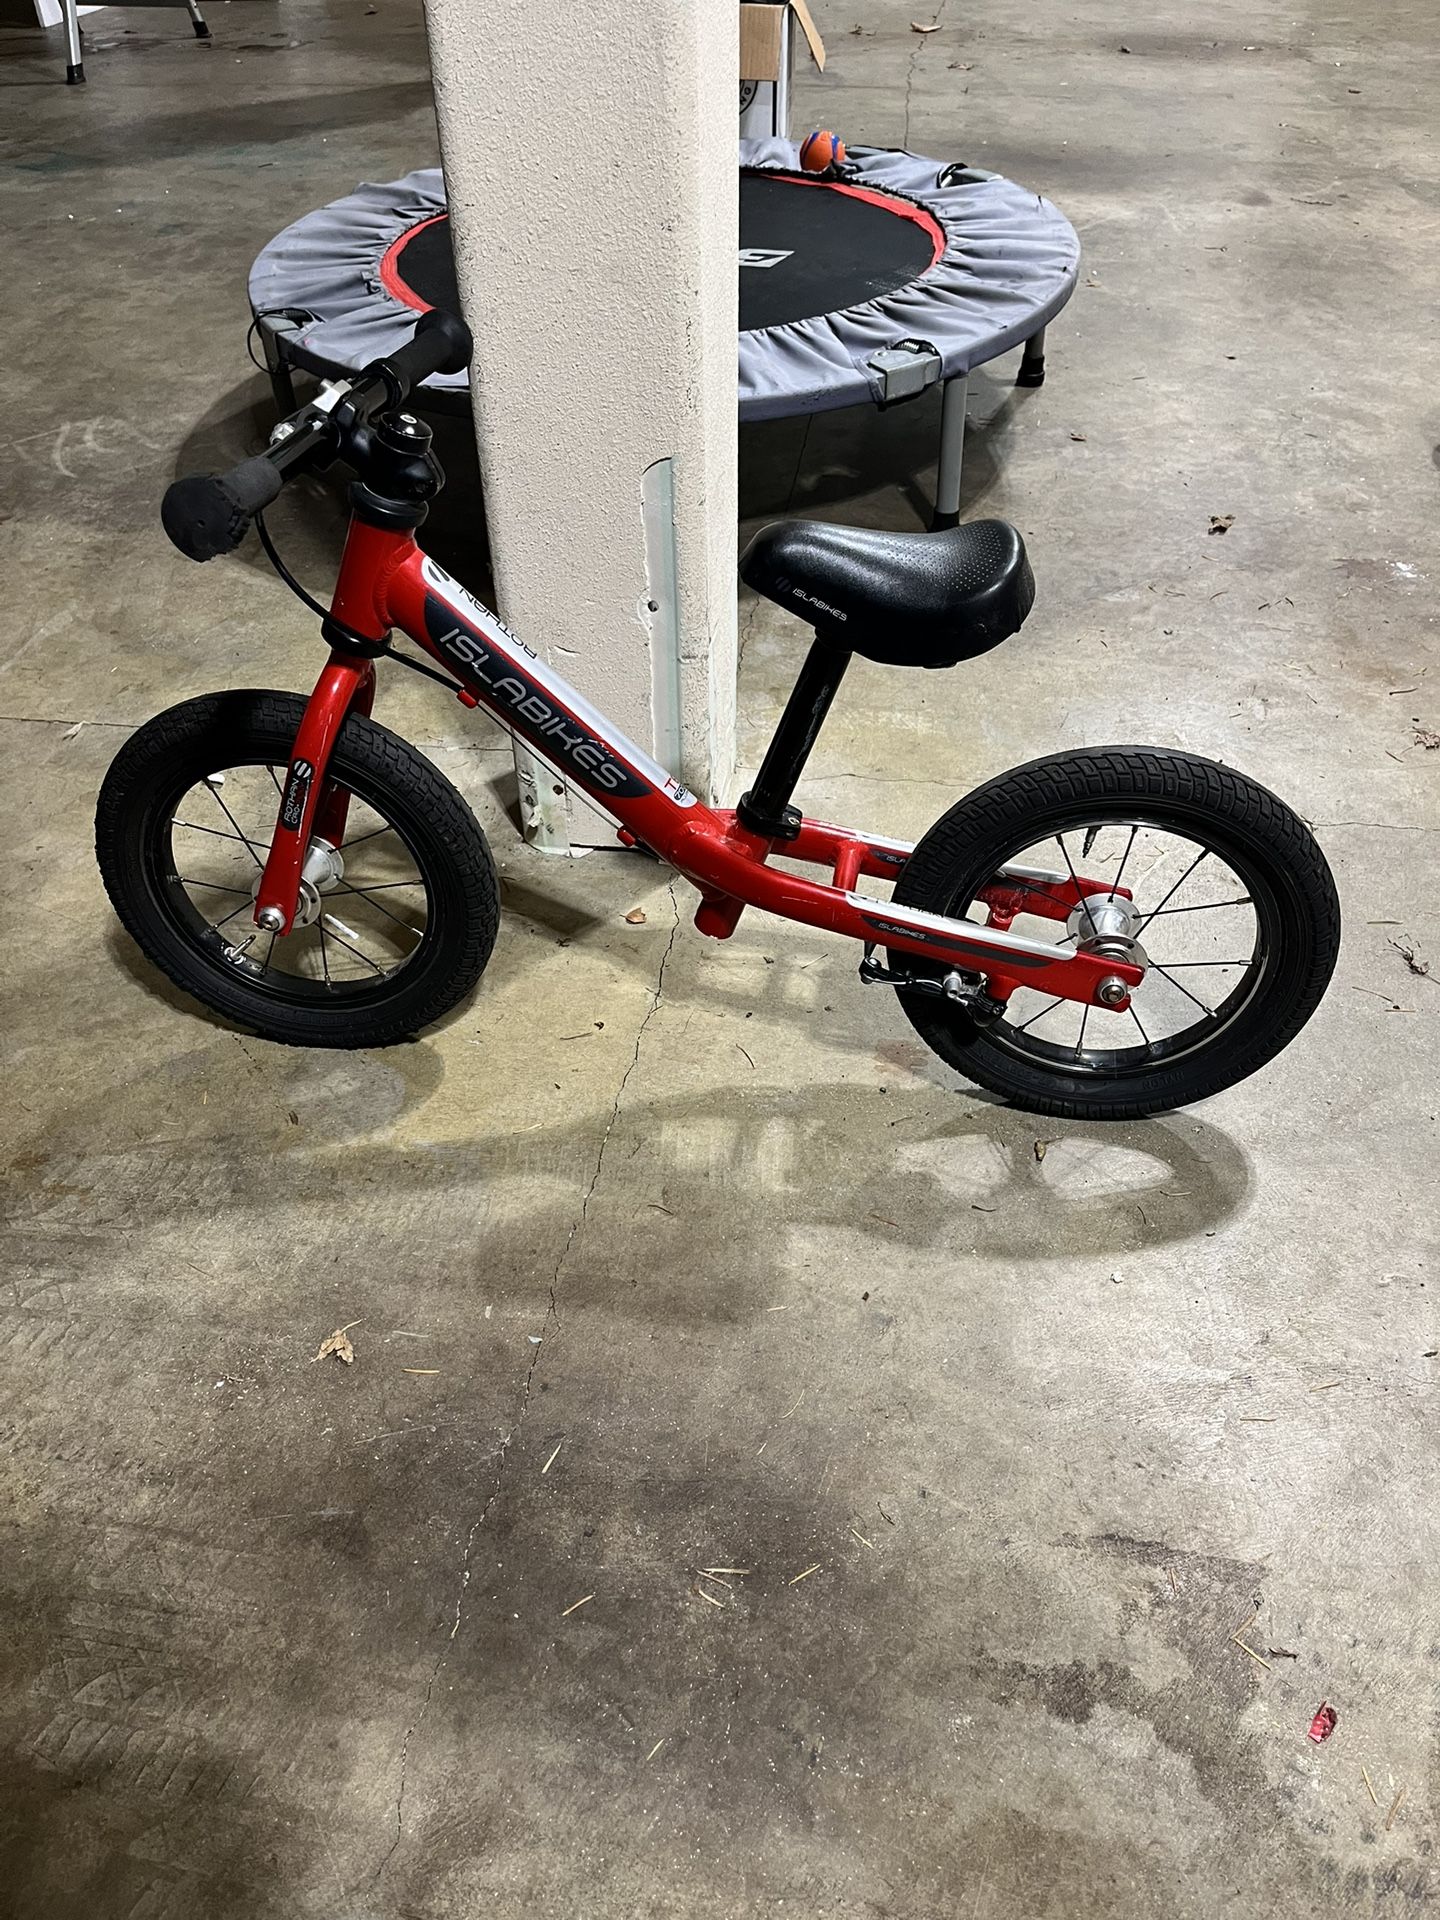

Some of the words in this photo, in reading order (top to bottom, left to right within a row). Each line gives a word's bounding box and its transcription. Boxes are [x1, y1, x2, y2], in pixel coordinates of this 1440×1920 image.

[459, 588, 537, 659] ROTHAN
[792, 588, 848, 621] ISLABIKES
[440, 628, 627, 788] ISLABIKES
